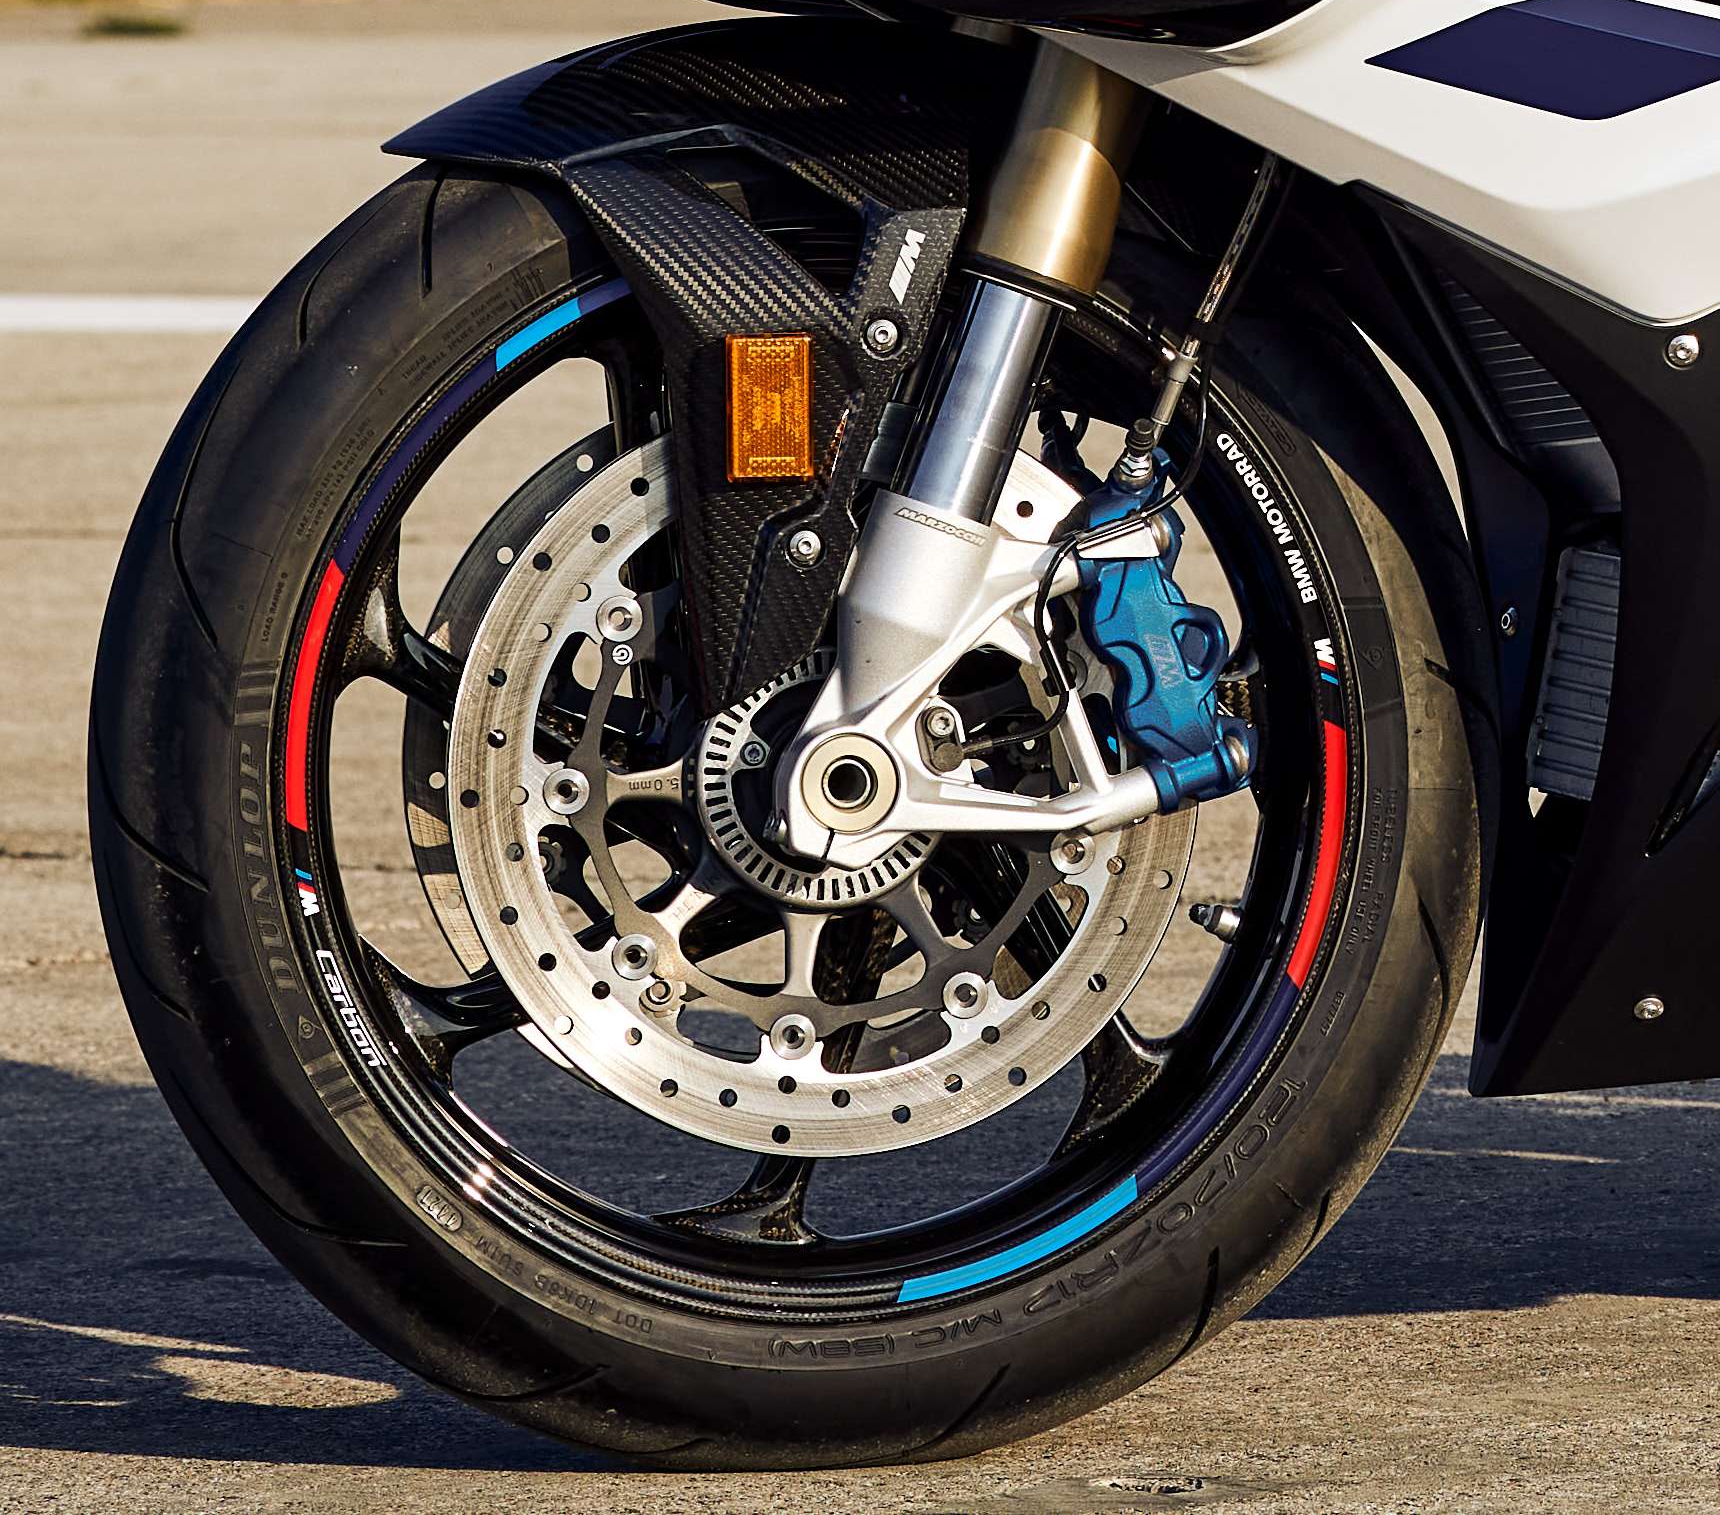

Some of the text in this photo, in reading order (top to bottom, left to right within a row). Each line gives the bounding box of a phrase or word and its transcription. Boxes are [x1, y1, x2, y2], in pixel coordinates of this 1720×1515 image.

[894, 506, 987, 547] MARZOCCHI
[1216, 431, 1296, 545] MOTORRAD
[1282, 540, 1318, 605] BMW
[238, 740, 300, 995] DUNLOP
[316, 949, 388, 1068] Carbon
[612, 1309, 655, 1336] DOT
